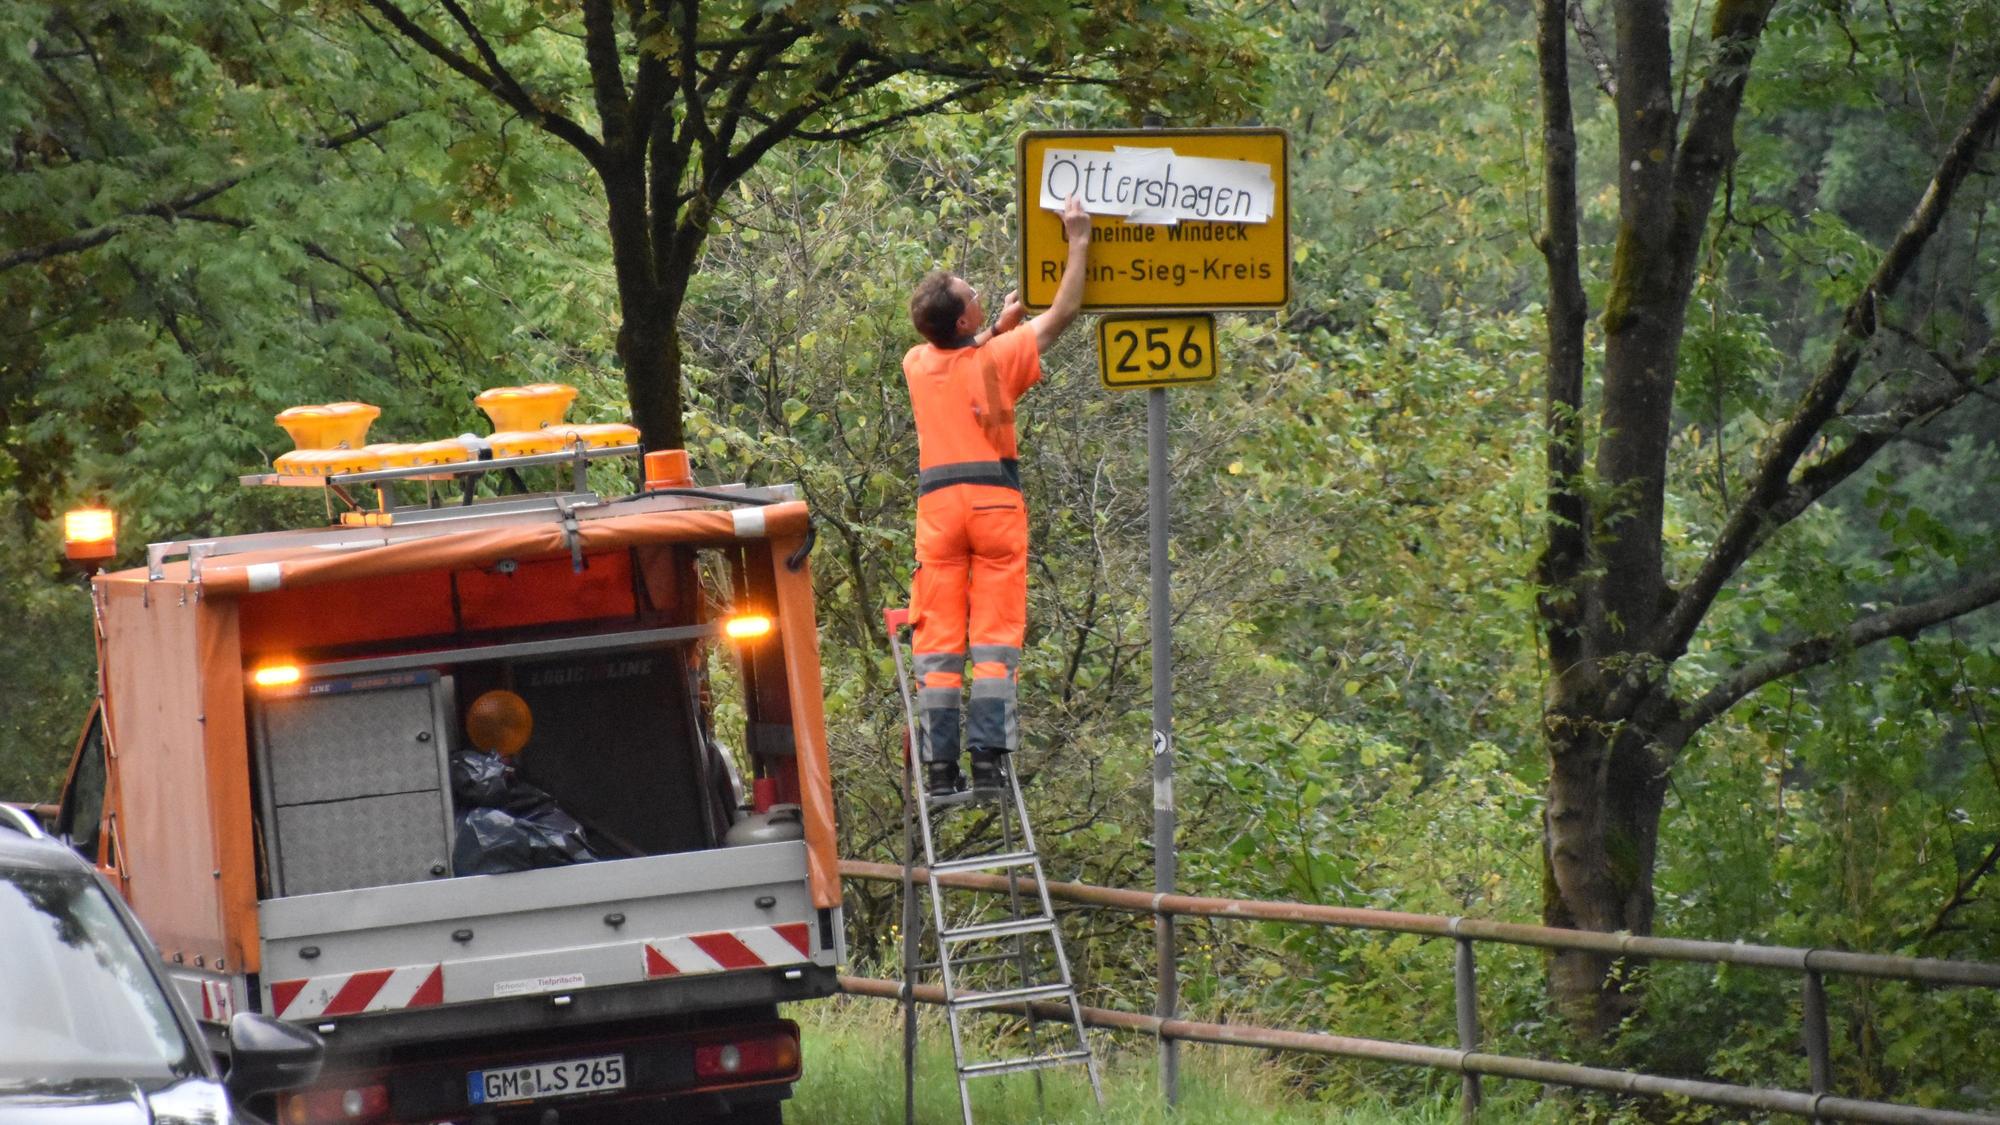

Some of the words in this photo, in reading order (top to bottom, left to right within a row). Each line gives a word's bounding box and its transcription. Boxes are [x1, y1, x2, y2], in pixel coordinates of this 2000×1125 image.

[1047, 153, 1251, 218] Öttershagen
[1061, 221, 1156, 243] meinde
[1167, 222, 1248, 243] Windeck
[1113, 325, 1203, 373] 256
[485, 1071, 519, 1098] GM
[536, 1066, 569, 1092] LS
[574, 1059, 621, 1089] 265
